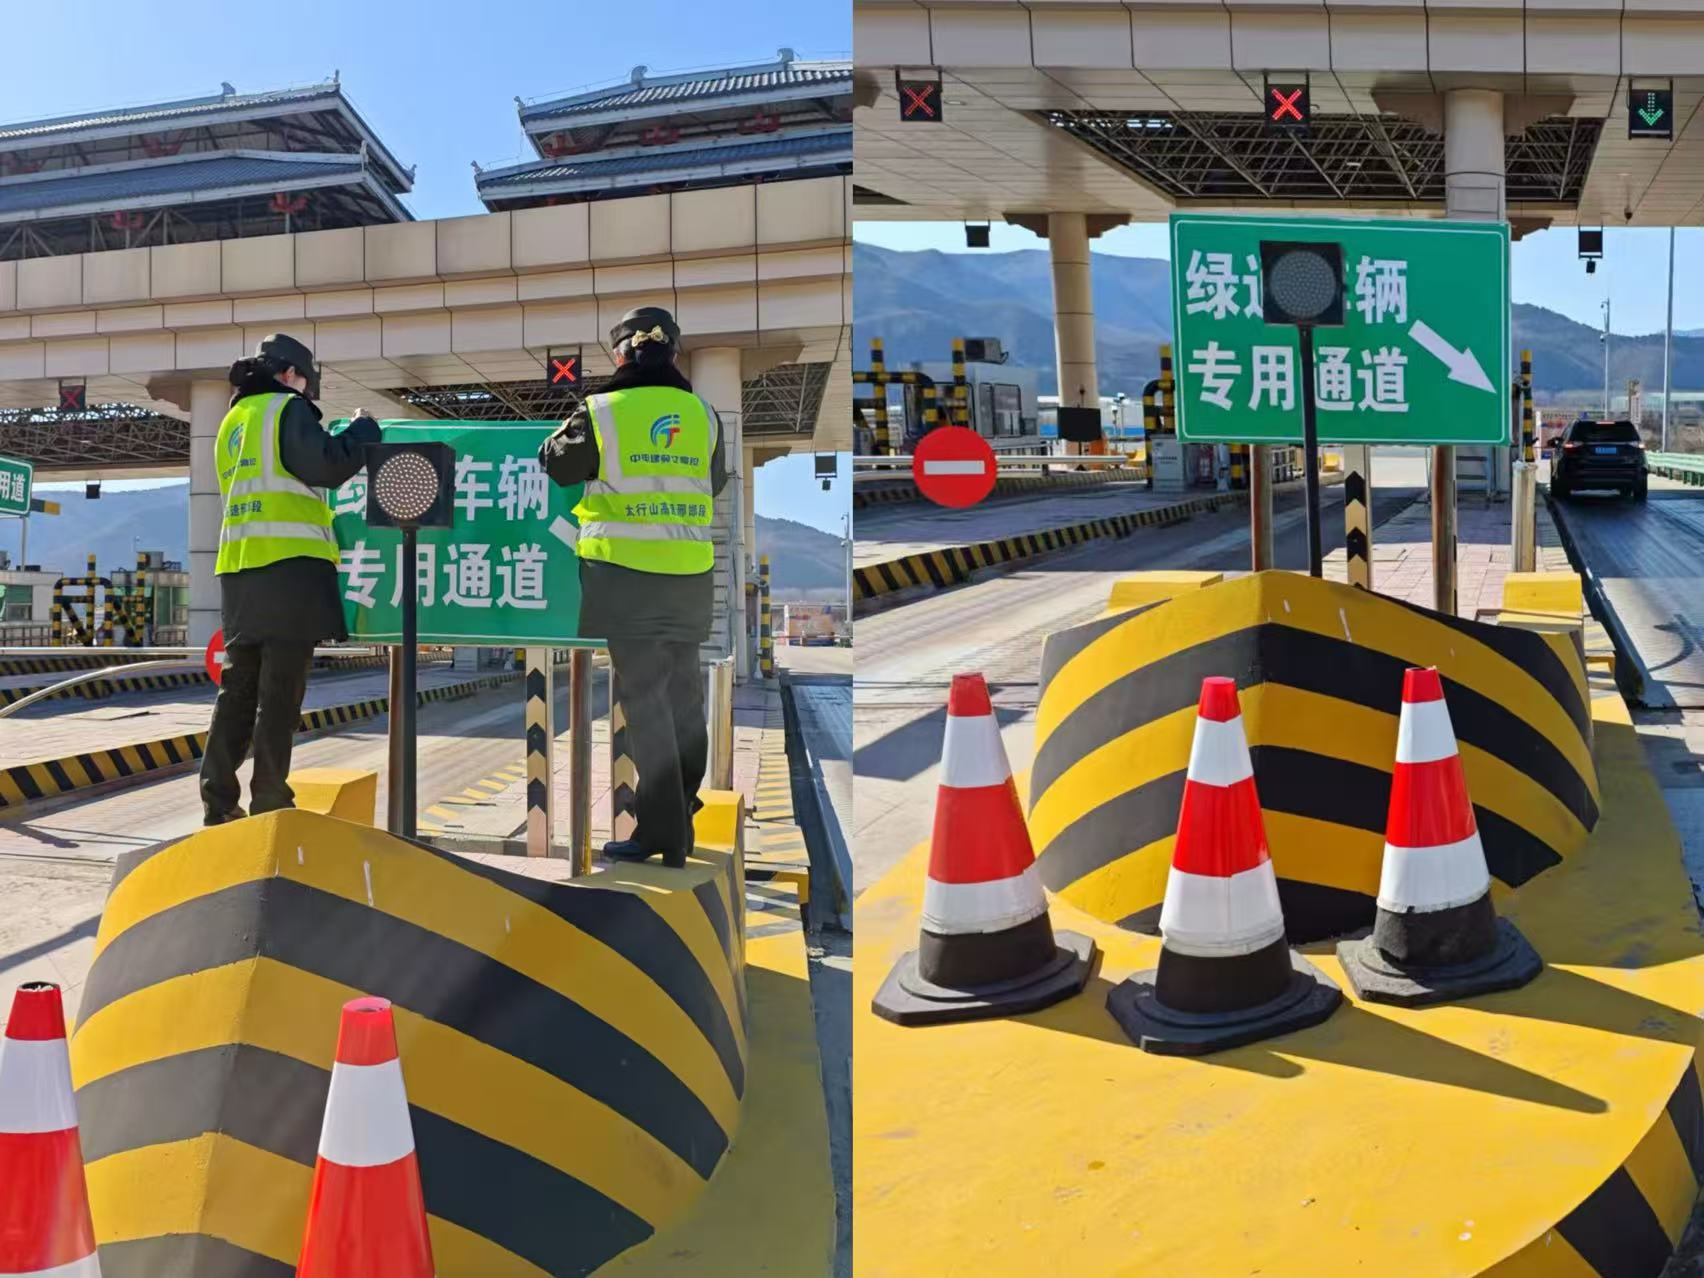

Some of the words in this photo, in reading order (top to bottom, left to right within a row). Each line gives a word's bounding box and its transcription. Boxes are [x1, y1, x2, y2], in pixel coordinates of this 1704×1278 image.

[1185, 250, 1408, 324] 绿辆
[1188, 341, 1410, 413] 专用通道
[335, 454, 549, 521] 车辆
[337, 540, 548, 610] 专用通道
